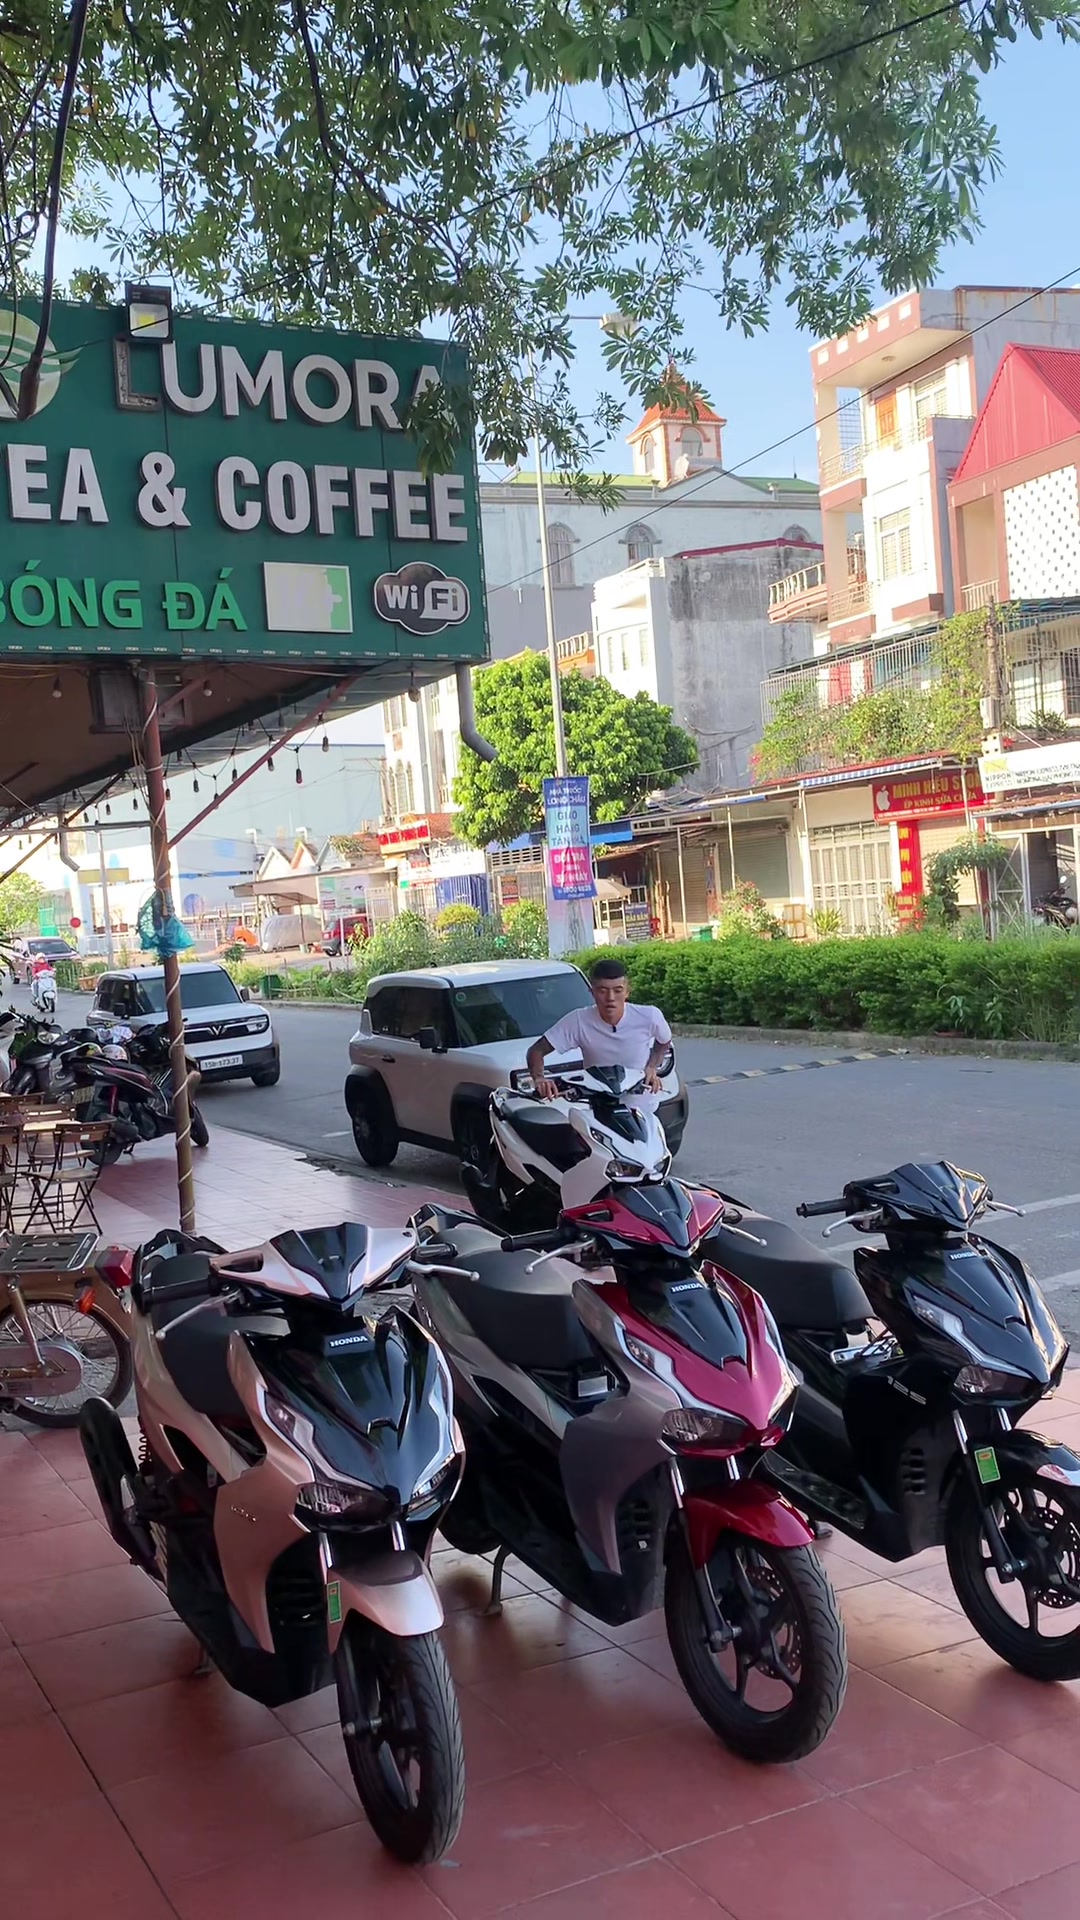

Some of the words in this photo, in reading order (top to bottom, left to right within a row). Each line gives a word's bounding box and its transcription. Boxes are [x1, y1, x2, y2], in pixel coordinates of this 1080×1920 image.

[7, 443, 109, 523] EA
[138, 451, 192, 528] &
[217, 456, 469, 542] COFFEE
[0, 560, 144, 629] ÓNG
[162, 567, 248, 631] ĐÁ
[557, 811, 578, 821] GIO
[950, 1251, 978, 1260] HONDA
[671, 1283, 704, 1293] HONDA
[330, 1335, 368, 1347] HONDA
